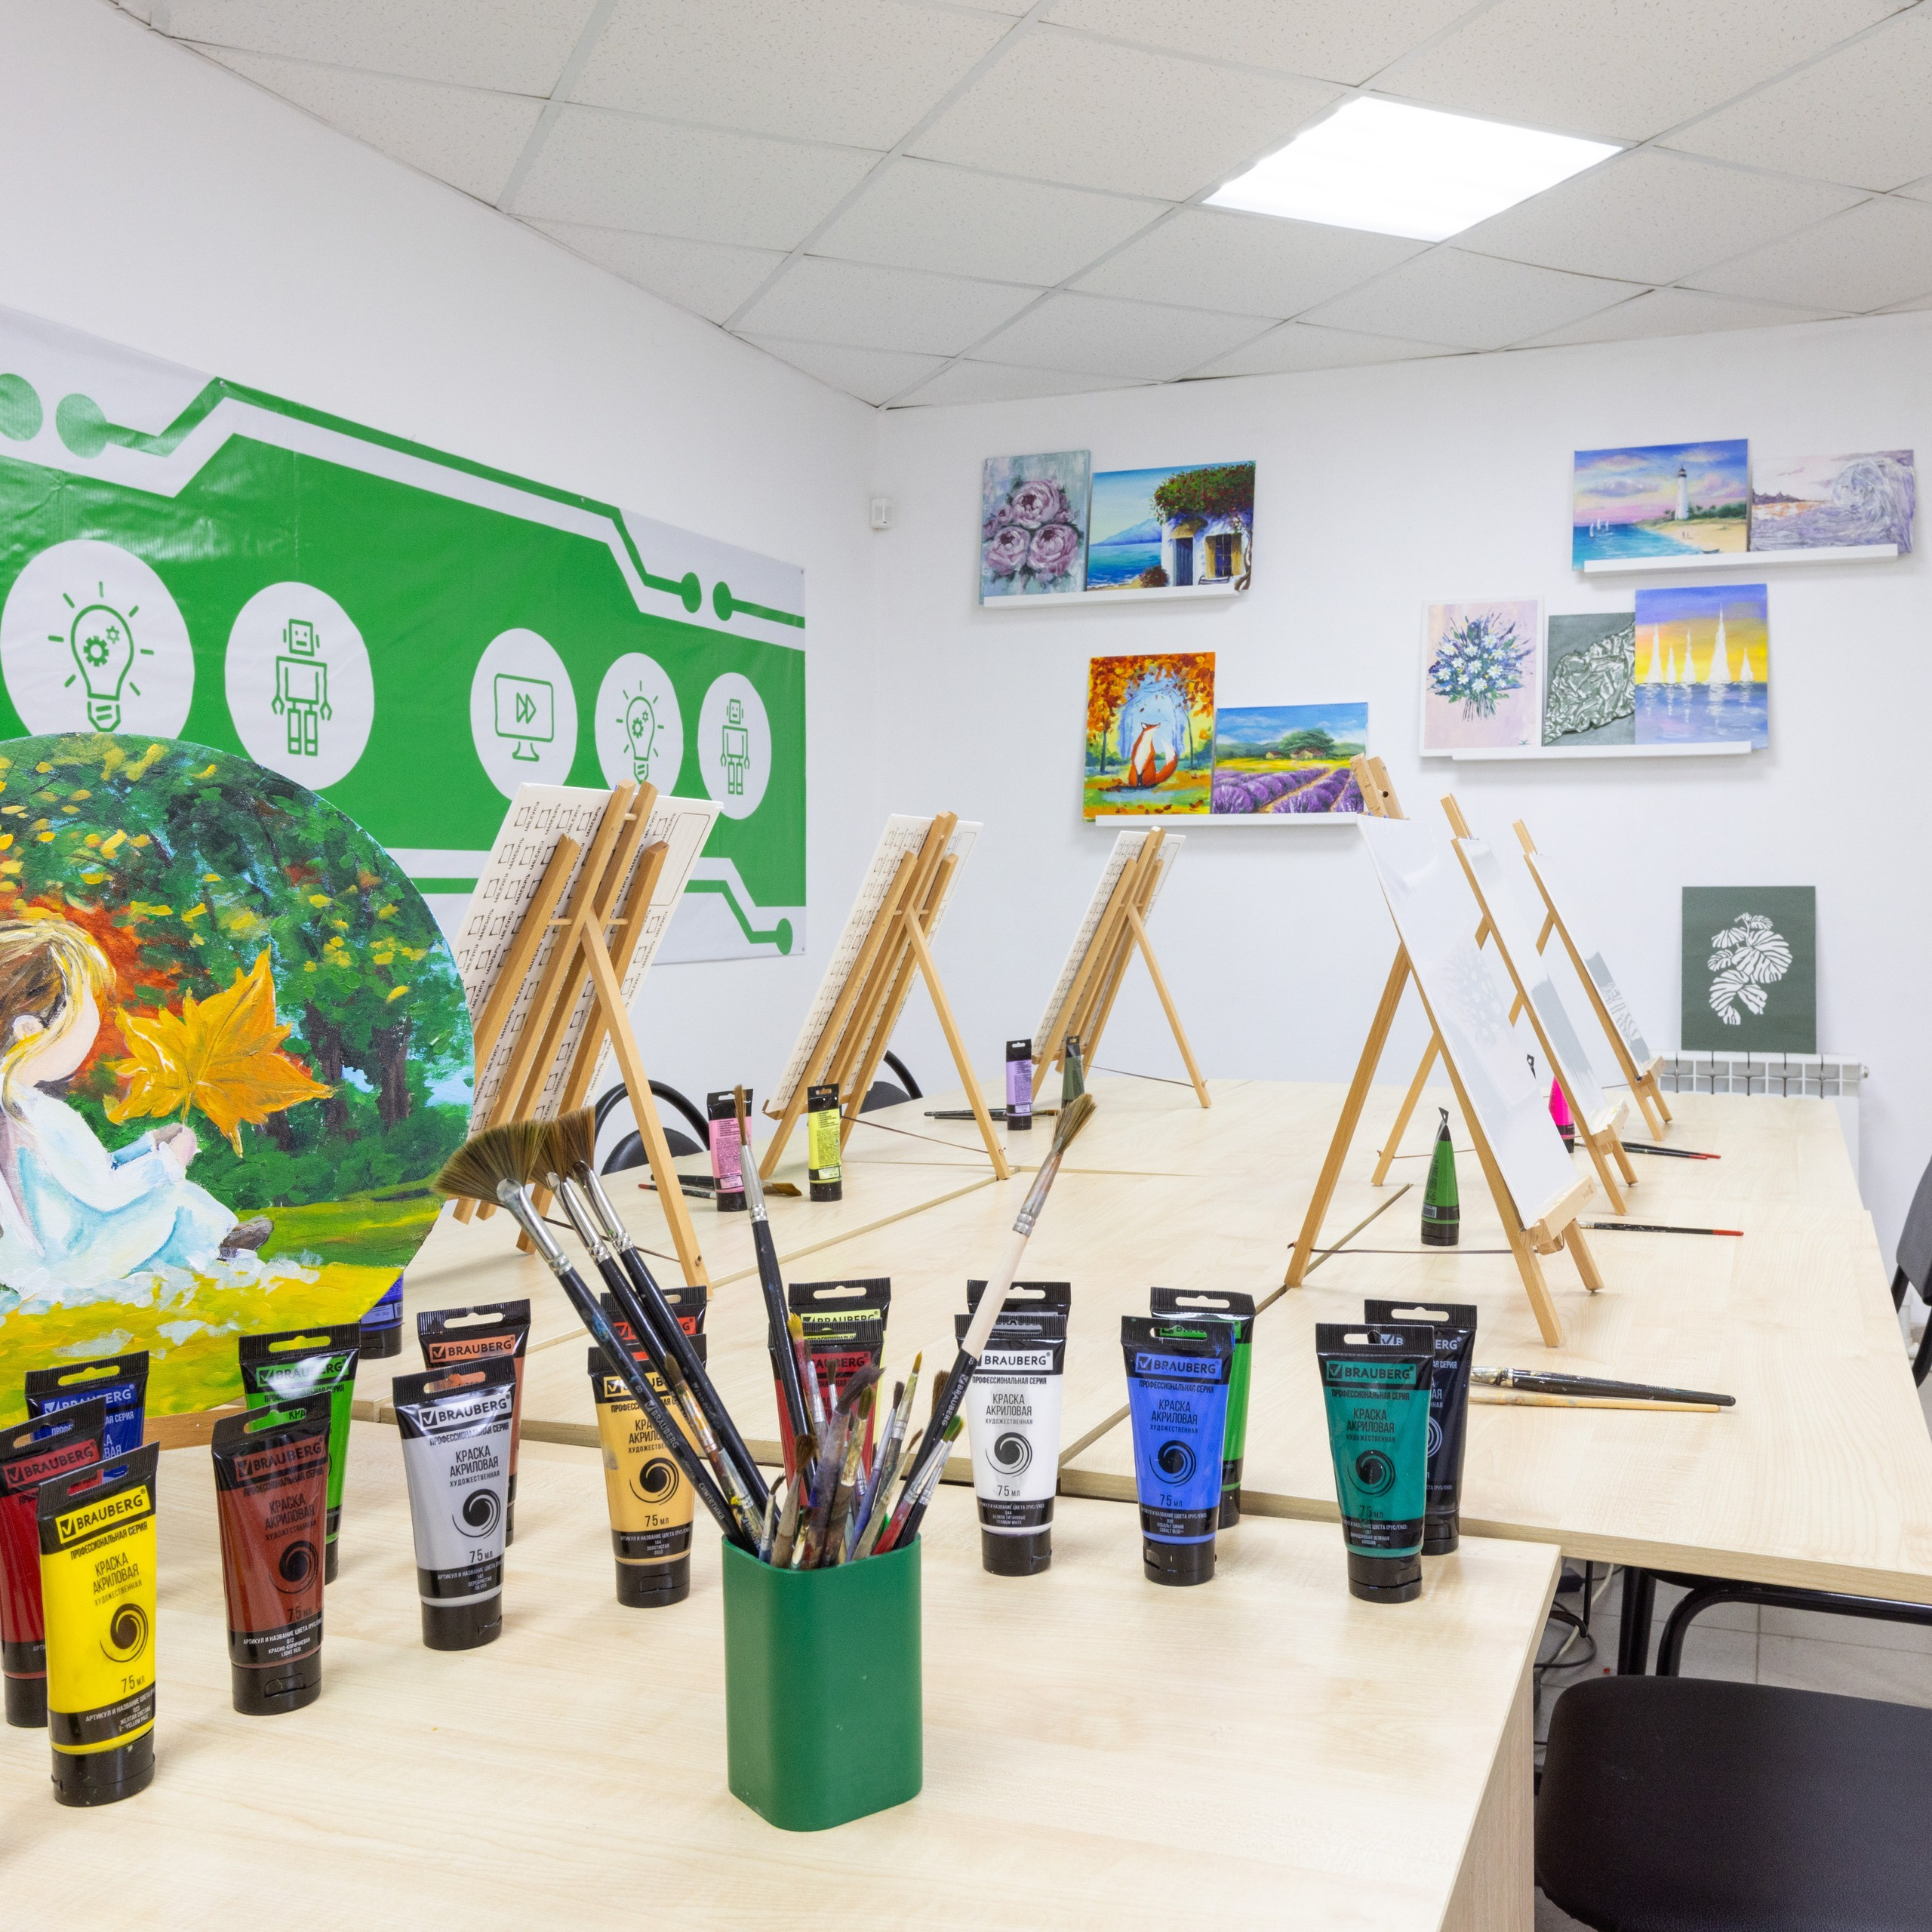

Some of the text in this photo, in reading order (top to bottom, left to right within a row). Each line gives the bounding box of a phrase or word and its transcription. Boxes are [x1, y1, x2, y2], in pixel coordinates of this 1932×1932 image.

[524, 801, 540, 832] MALEVICH
[566, 804, 581, 834] MALEVICH
[529, 841, 545, 870] MALEVICH
[494, 872, 509, 903] MALEVICH
[500, 911, 515, 940] MALEVICH
[464, 944, 479, 974] MALEVICH
[471, 980, 485, 1009] MALEVICH
[486, 1044, 500, 1072] MALEVICH
[1440, 1361, 1457, 1369] СЕРИЯ
[635, 1385, 643, 1394] 8
[972, 1377, 1029, 1385] ПРОФЕССИОНАЛЬНАЯ
[1139, 1380, 1214, 1394] ПРОФЕССИОНАЛЬНАЯ СЕРИЯ
[992, 1394, 1025, 1404] КРАСКА
[1331, 1389, 1410, 1401] ПРОФЕССИОНАЛЬНАЯ СЕРИЯ
[940, 1383, 964, 1426] BRAUBERG
[986, 1406, 1032, 1416] АКРИЛОВАЯ
[1158, 1399, 1191, 1413] КРАСКА
[115, 1411, 134, 1423] СЕРИЯ
[1151, 1411, 1198, 1425] АКРИЛОВАЯ
[1353, 1408, 1387, 1421] КРАСКА
[429, 1422, 509, 1446] ПРОФЕССИОНАЛЬНАЯ СЕРИЯ
[651, 1410, 679, 1449] BRAUBERG
[1149, 1424, 1198, 1434] ХУДОЖЕСТВЕННАЯ
[1346, 1420, 1395, 1433] АКРИЛОВАЯ
[629, 1431, 661, 1444] АКРИЛО
[1346, 1435, 1395, 1443] ХУДОЖЕСТВЕННАЯ
[456, 1445, 491, 1463] КРАСКА
[450, 1456, 499, 1478] АКРИЛОВАЯ
[449, 1470, 500, 1487] ХУДОЖЕСТВЕННАЯ
[997, 1484, 1010, 1497] 75
[269, 1493, 306, 1515] КРАСКА
[1160, 1494, 1172, 1506] 75
[265, 1505, 315, 1531] АКРИЛОВАЯ
[645, 1514, 658, 1527] 75
[1359, 1505, 1372, 1518] 75
[265, 1519, 316, 1541] ХУДОЖЕСТВЕННАЯ
[70, 1521, 148, 1560] ПРОФЕССИОНАЛЬНАЯ СЕРИЯ
[94, 1552, 129, 1577] КРАСКА
[469, 1549, 482, 1564] 75
[93, 1564, 140, 1595] АКРИЛОВАЯ
[94, 1580, 143, 1606] ХУДОЖЕСТВЕННАЯ
[287, 1606, 302, 1622] 75
[243, 1636, 265, 1644] АРТИКУЛ
[269, 1630, 294, 1641] НАЗВАНИЕ
[294, 1626, 308, 1635] ЦВЕТА
[121, 1675, 136, 1694] 75
[85, 1709, 111, 1721] АРТИКУЛ
[116, 1697, 140, 1712] НАЗВАНИЕ
